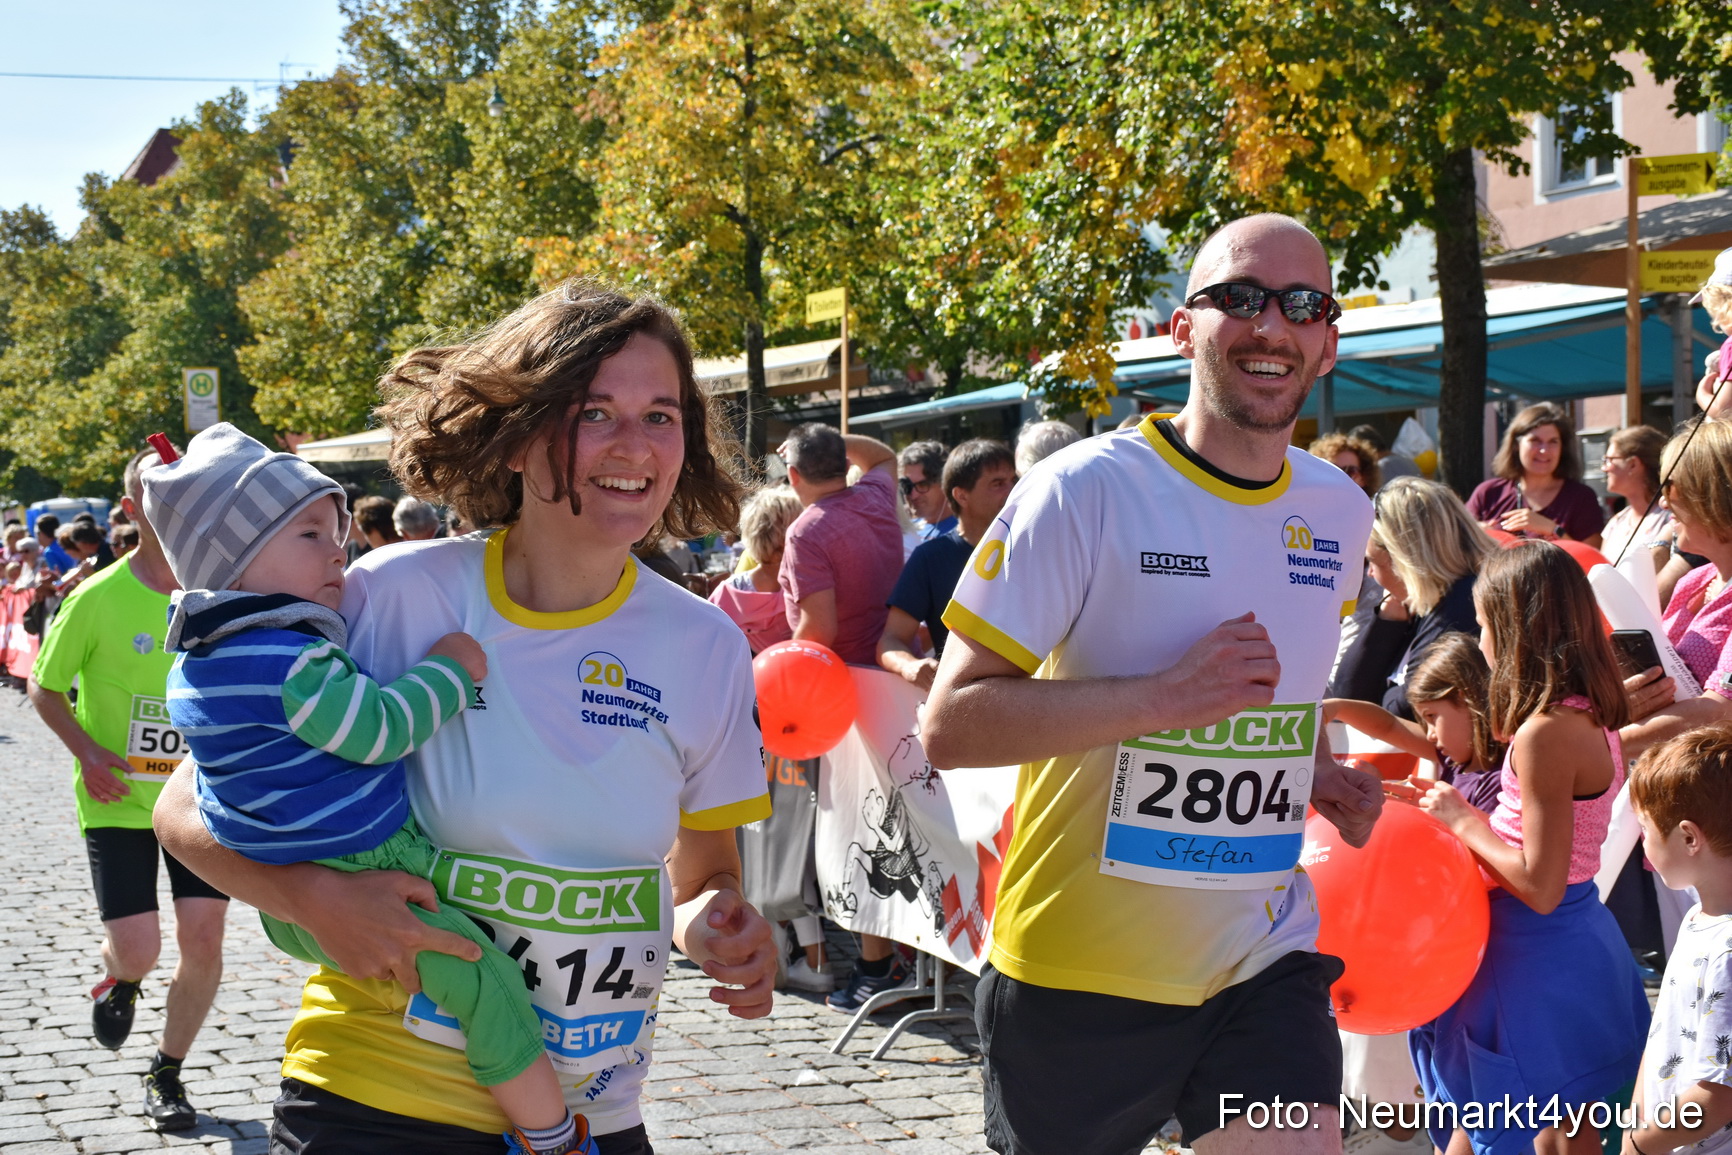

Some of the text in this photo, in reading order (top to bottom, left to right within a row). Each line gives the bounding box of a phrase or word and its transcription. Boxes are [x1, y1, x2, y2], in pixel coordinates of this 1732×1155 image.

[1637, 162, 1701, 175] tartnummern-
[1648, 178, 1686, 192] ausgabe
[1648, 259, 1711, 270] Kleiderbeutel-
[1660, 273, 1697, 286] ausgabe
[814, 299, 842, 312] Toiletten
[1285, 525, 1338, 552] 20 JAHRE
[1141, 552, 1209, 572] BOCK
[1287, 553, 1343, 571] Neumarkter
[1289, 572, 1335, 591] Stadtlauf
[582, 659, 660, 700] 20 JAHRE
[581, 689, 669, 724] Neumarkter
[581, 710, 650, 733] Stadtlauf
[1137, 763, 1290, 825] 2804
[1156, 837, 1254, 870] Stefan
[448, 858, 645, 926] BOCK
[474, 918, 635, 1007] 414
[646, 950, 655, 962] D
